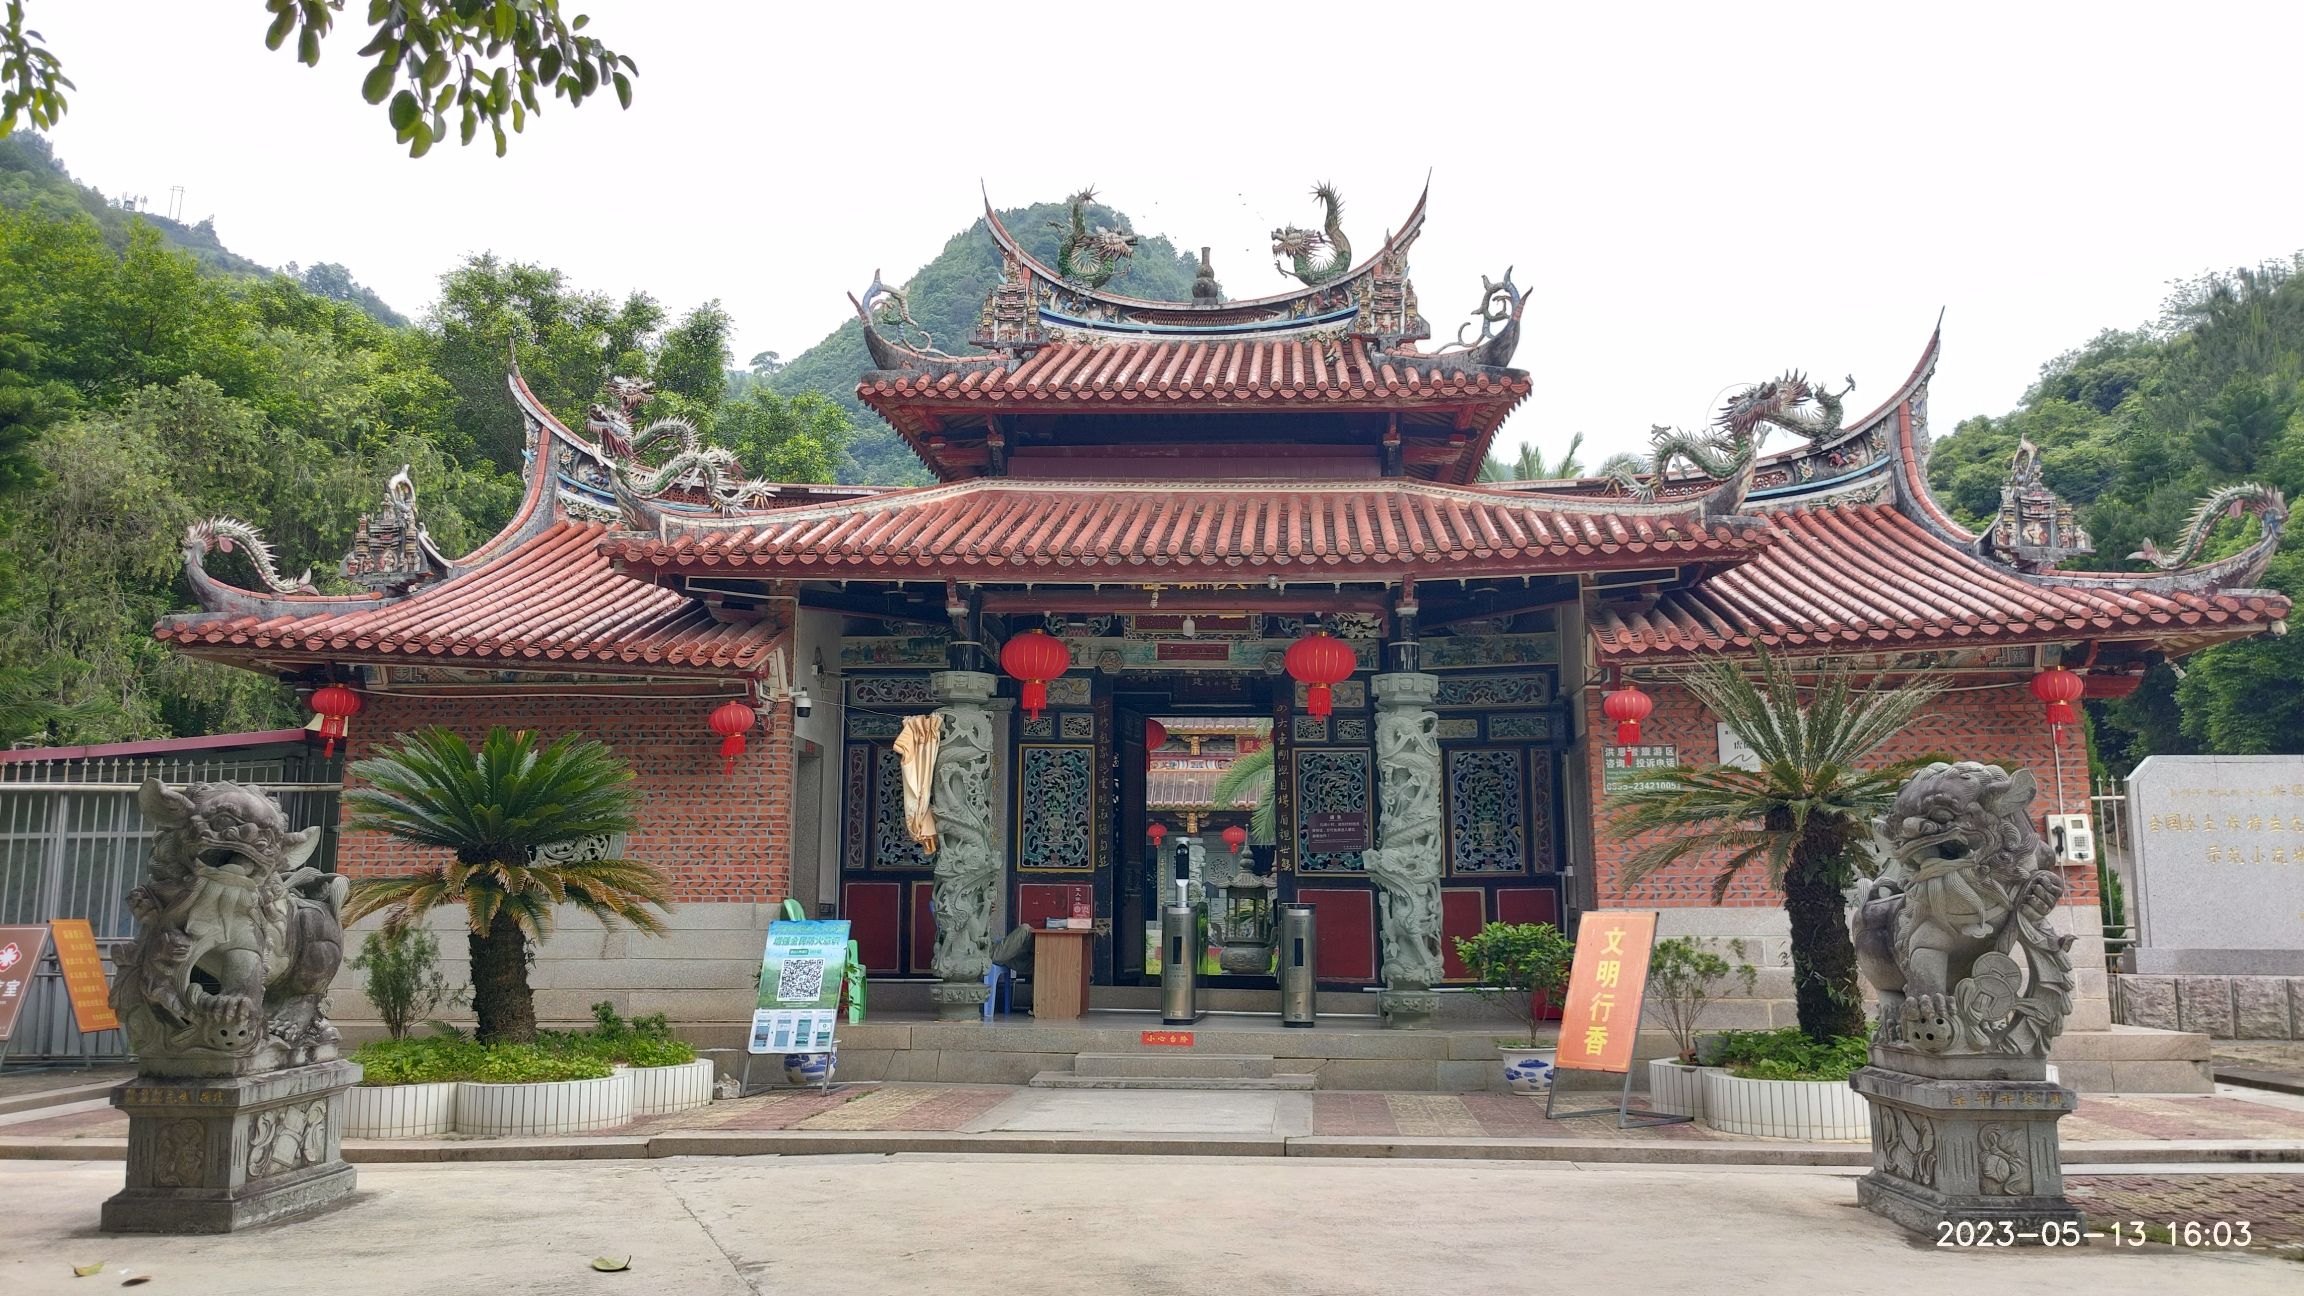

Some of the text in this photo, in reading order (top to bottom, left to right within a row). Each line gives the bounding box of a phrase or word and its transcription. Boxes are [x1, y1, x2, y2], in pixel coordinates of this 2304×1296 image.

[1584, 926, 1627, 1056] 文明行香
[1146, 1034, 1189, 1044] 小心台阶
